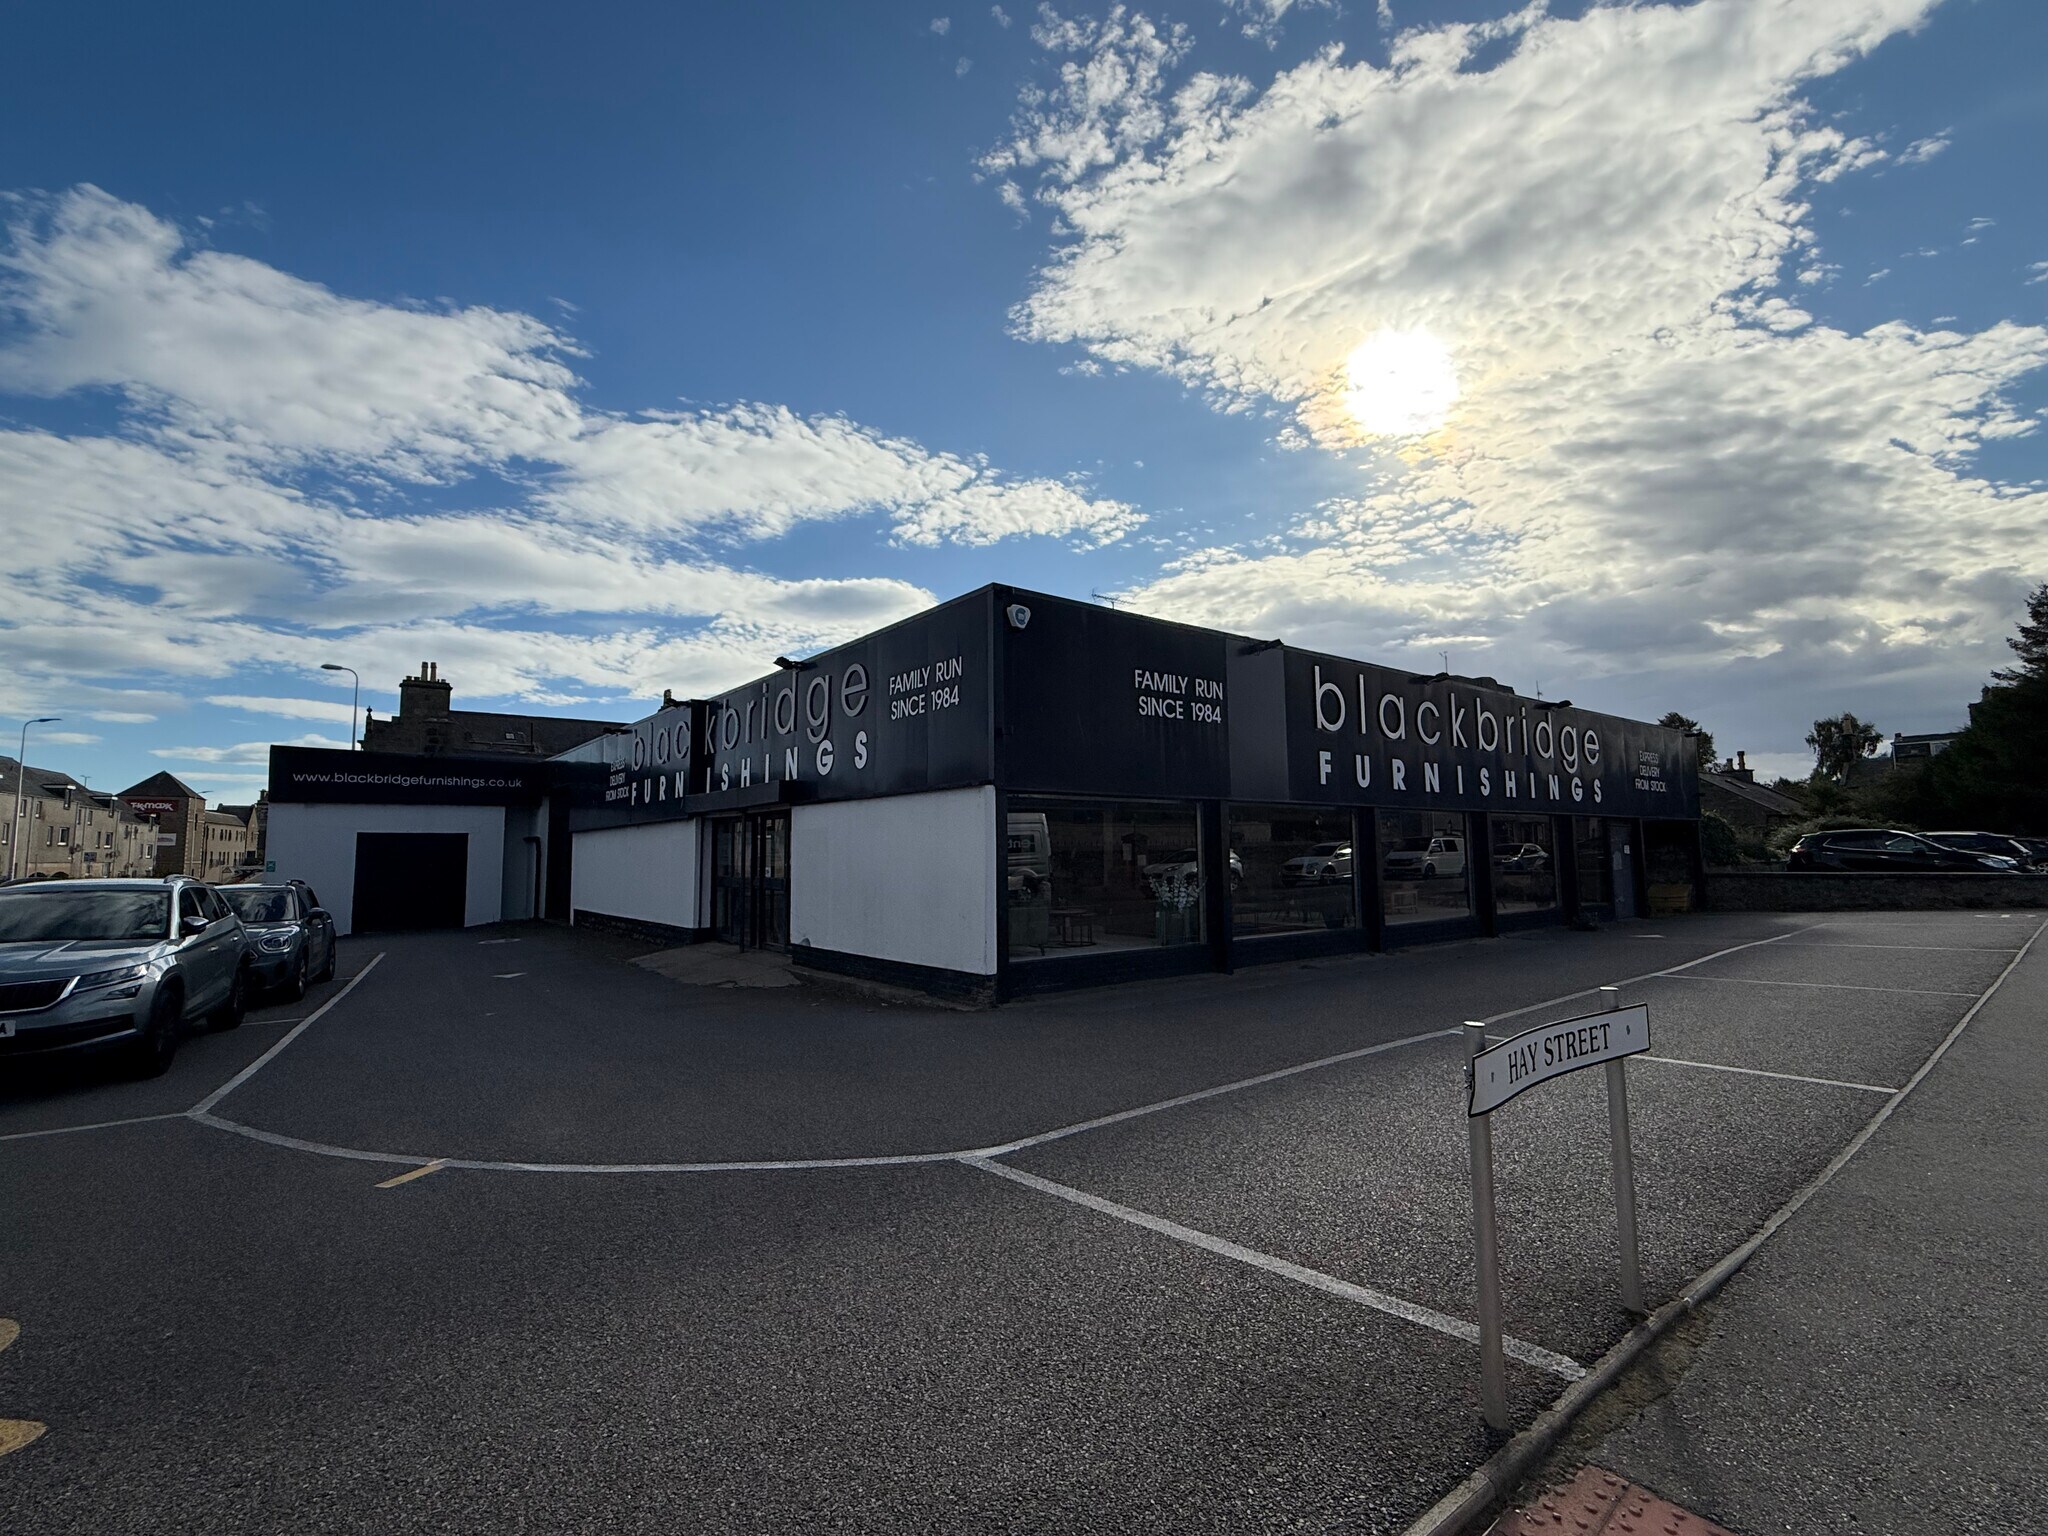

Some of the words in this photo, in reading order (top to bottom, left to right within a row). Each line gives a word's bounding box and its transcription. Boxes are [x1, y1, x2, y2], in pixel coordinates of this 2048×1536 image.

[889, 666, 931, 695] FAMILY
[936, 656, 962, 682] RUN
[1134, 669, 1188, 694] FAMILY
[1195, 678, 1223, 700] RUN
[631, 663, 869, 772] blackbridge
[891, 694, 926, 720] SINCE
[931, 685, 960, 711] 1984
[1138, 696, 1184, 719] SINCE
[1190, 702, 1222, 723] 1984
[1314, 665, 1600, 774] blackbridge
[293, 772, 522, 788] www.blackbridgefurnishings.co.uk
[631, 731, 868, 806] FURNISHINGS
[1319, 751, 1602, 803] FURNISHINGS
[1508, 1042, 1538, 1084] HAY
[1544, 1023, 1610, 1066] STREET
